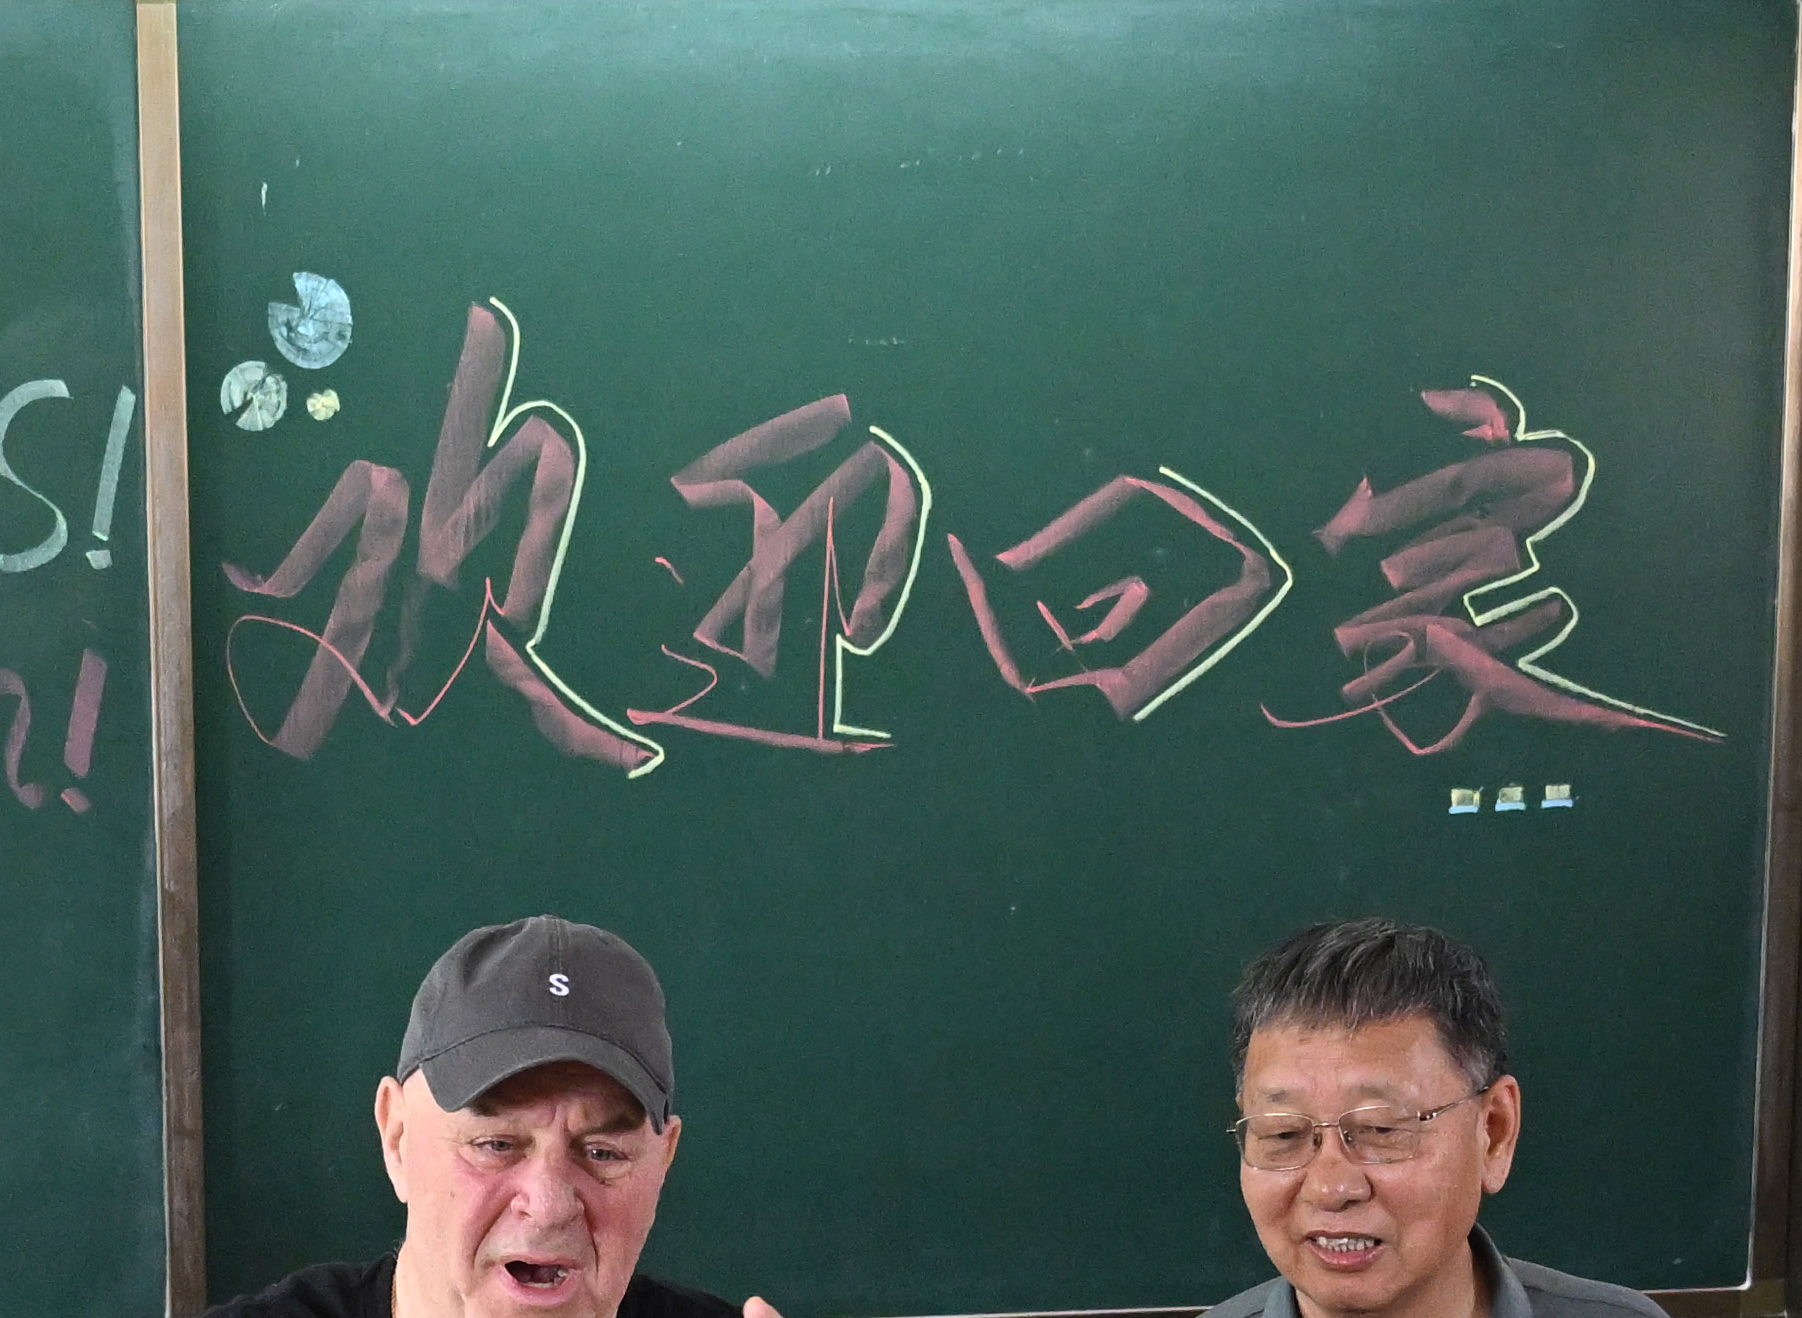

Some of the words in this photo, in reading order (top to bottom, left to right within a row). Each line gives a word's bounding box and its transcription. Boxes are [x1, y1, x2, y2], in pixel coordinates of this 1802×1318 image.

[222, 296, 1727, 779] 欢迎回家
[549, 973, 570, 997] S
